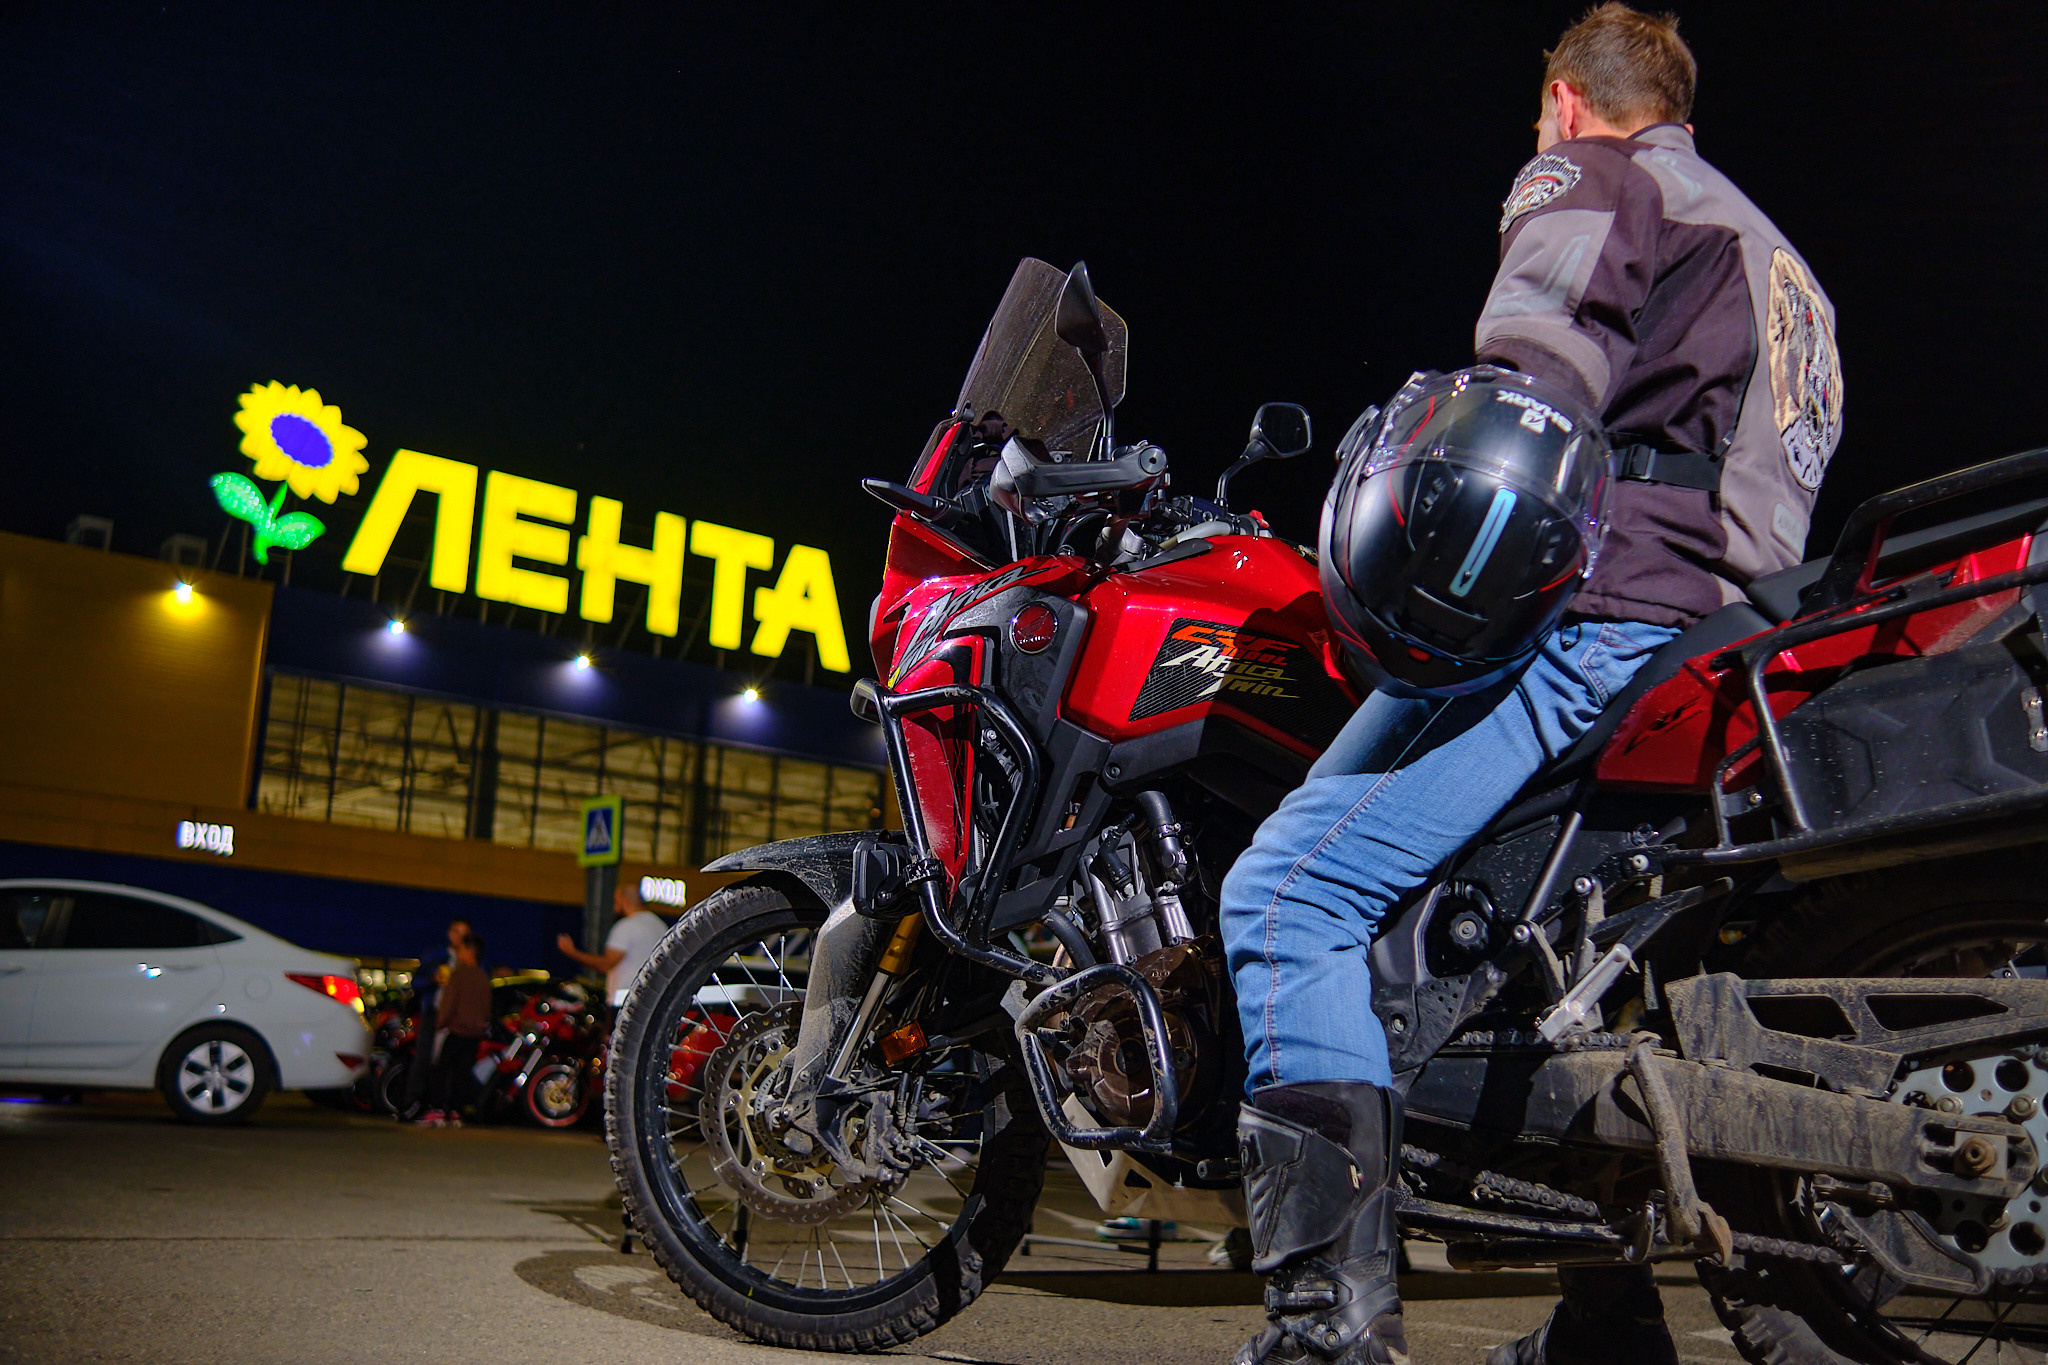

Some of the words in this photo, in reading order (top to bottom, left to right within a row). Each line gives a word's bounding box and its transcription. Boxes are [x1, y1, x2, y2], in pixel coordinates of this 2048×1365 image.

[1496, 389, 1573, 433] SHARK
[342, 448, 851, 674] ЛЕНТА
[1171, 625, 1300, 651] CRF
[1159, 645, 1298, 681] Africa
[1197, 671, 1300, 698] Twin
[177, 820, 234, 856] ВХОД
[640, 875, 686, 908] ВХОД
